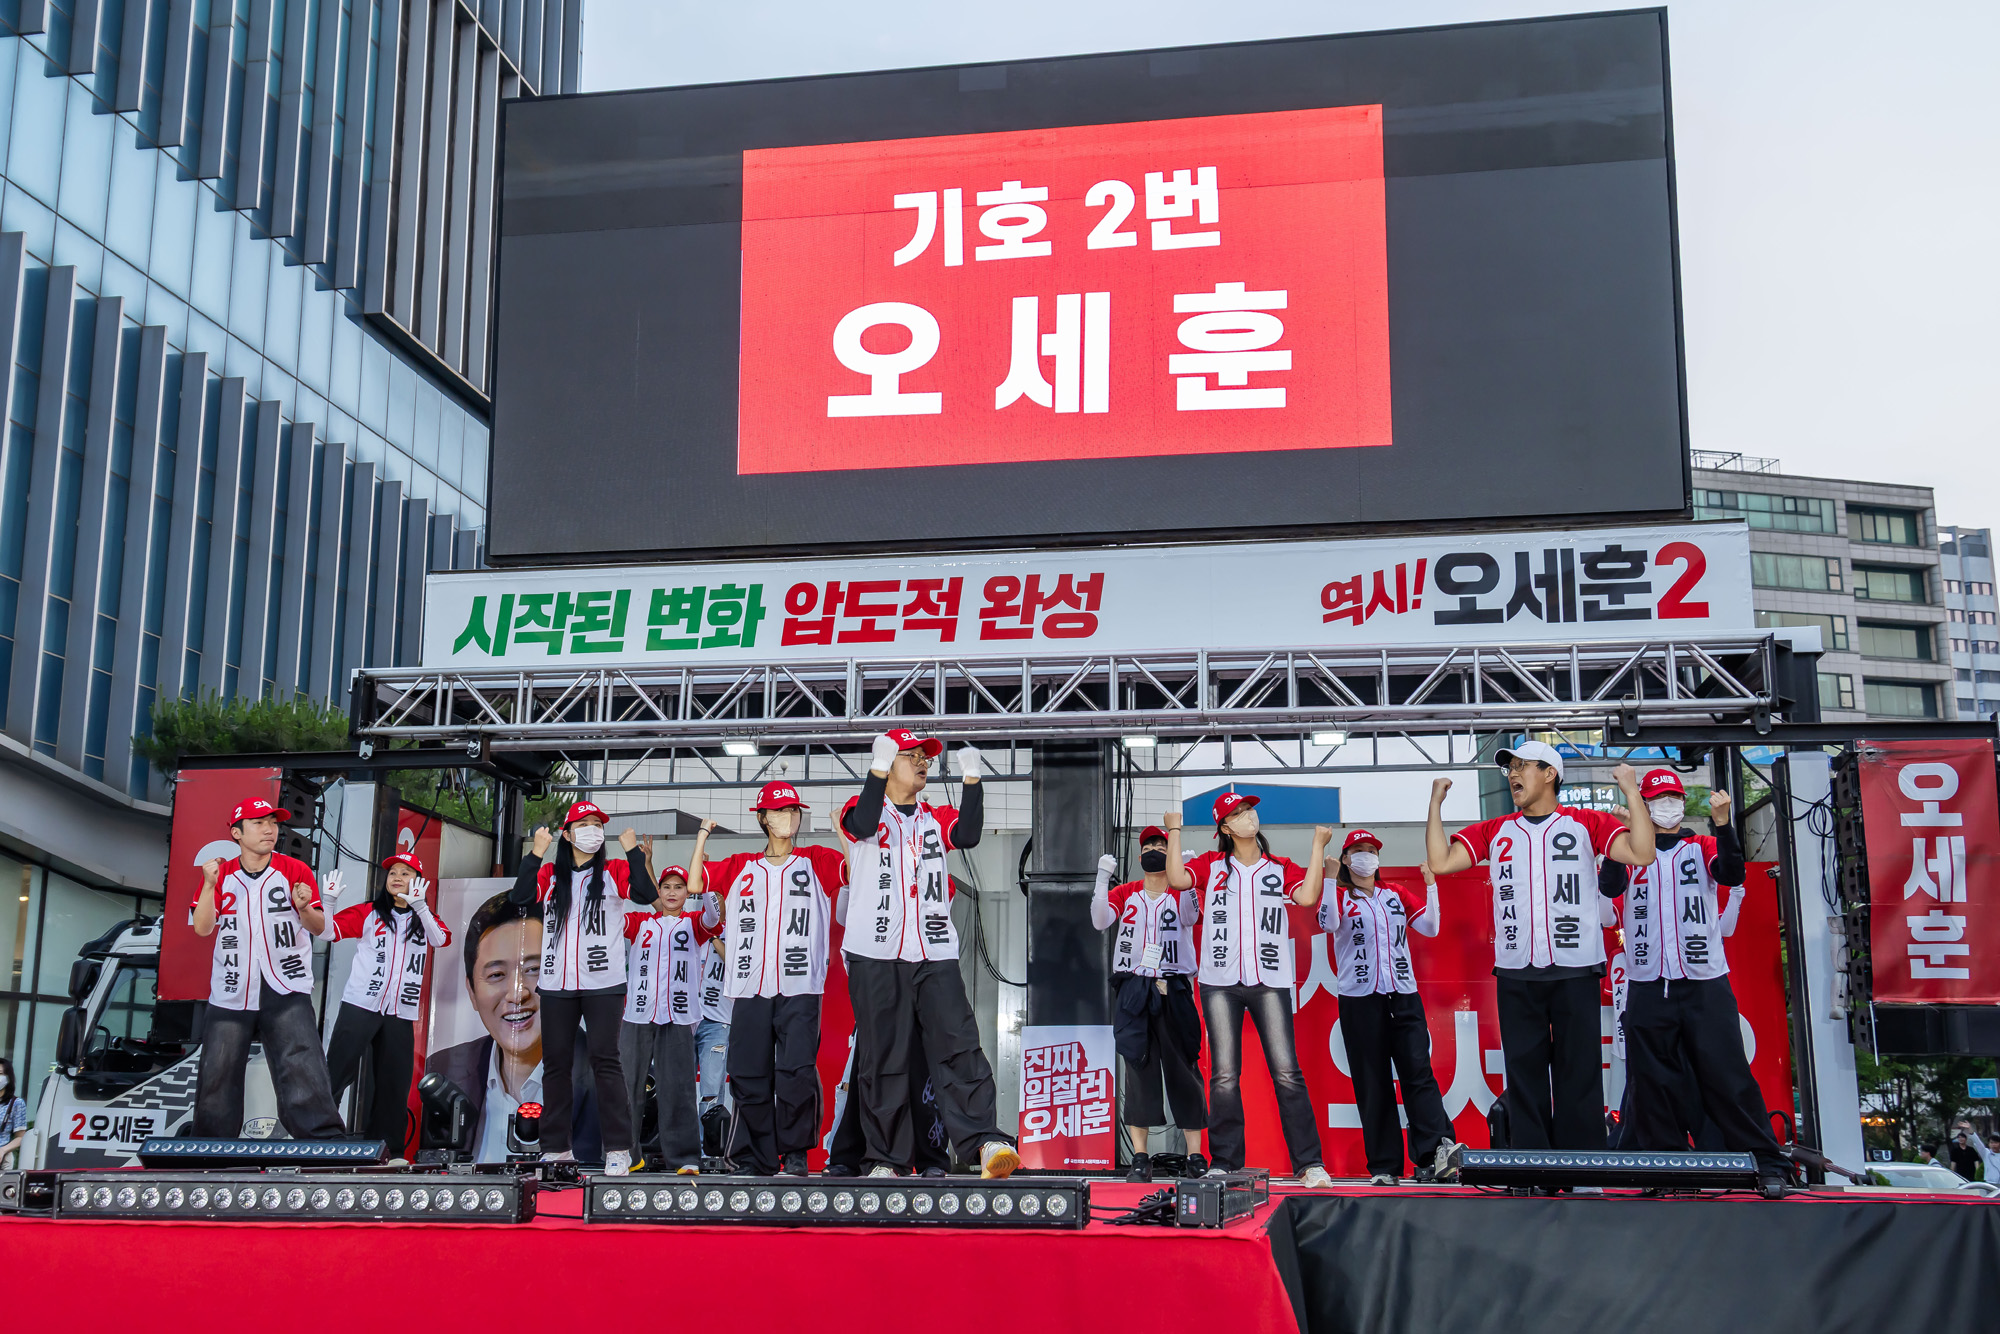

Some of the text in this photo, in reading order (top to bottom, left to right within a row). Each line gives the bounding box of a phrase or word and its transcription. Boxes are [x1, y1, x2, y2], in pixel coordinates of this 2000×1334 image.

[893, 165, 1222, 267] 기호 2번
[452, 572, 1105, 657] 시작된 변화 압도적 완성
[1320, 558, 1428, 627] 역시!
[1651, 775, 1675, 786] 오세훈
[234, 806, 242, 819] 2
[877, 823, 890, 850] 2
[1497, 837, 1513, 863] 2
[1898, 762, 1970, 979] 오세훈
[220, 892, 237, 915] 2
[328, 882, 336, 891] 2
[413, 888, 420, 897] 2
[740, 873, 754, 897] 2
[874, 852, 891, 933] 서울시장
[1214, 871, 1228, 892] 2
[1346, 900, 1361, 917] 2
[1498, 864, 1518, 941] 서울시장
[1552, 832, 1580, 949] 오세훈
[267, 886, 306, 980] 오세훈
[374, 918, 386, 938] 2
[739, 899, 756, 970] 서울시장
[783, 870, 812, 977] 오세훈
[1122, 905, 1138, 925] 2
[1211, 893, 1228, 960] 서울시장
[1260, 874, 1283, 971] 오세훈
[1632, 886, 1649, 959] 서울시장
[1679, 858, 1709, 964] 오세훈
[220, 917, 239, 985] 서울시장
[642, 930, 653, 949] 2
[1350, 917, 1370, 977] 서울시장
[636, 950, 650, 1006] 서울시장
[672, 930, 689, 1014] 오세훈
[1614, 967, 1625, 985] 2
[1025, 1043, 1081, 1079] 진짜
[1025, 1070, 1107, 1110] 일잘러
[1022, 1101, 1111, 1144] 오세훈
